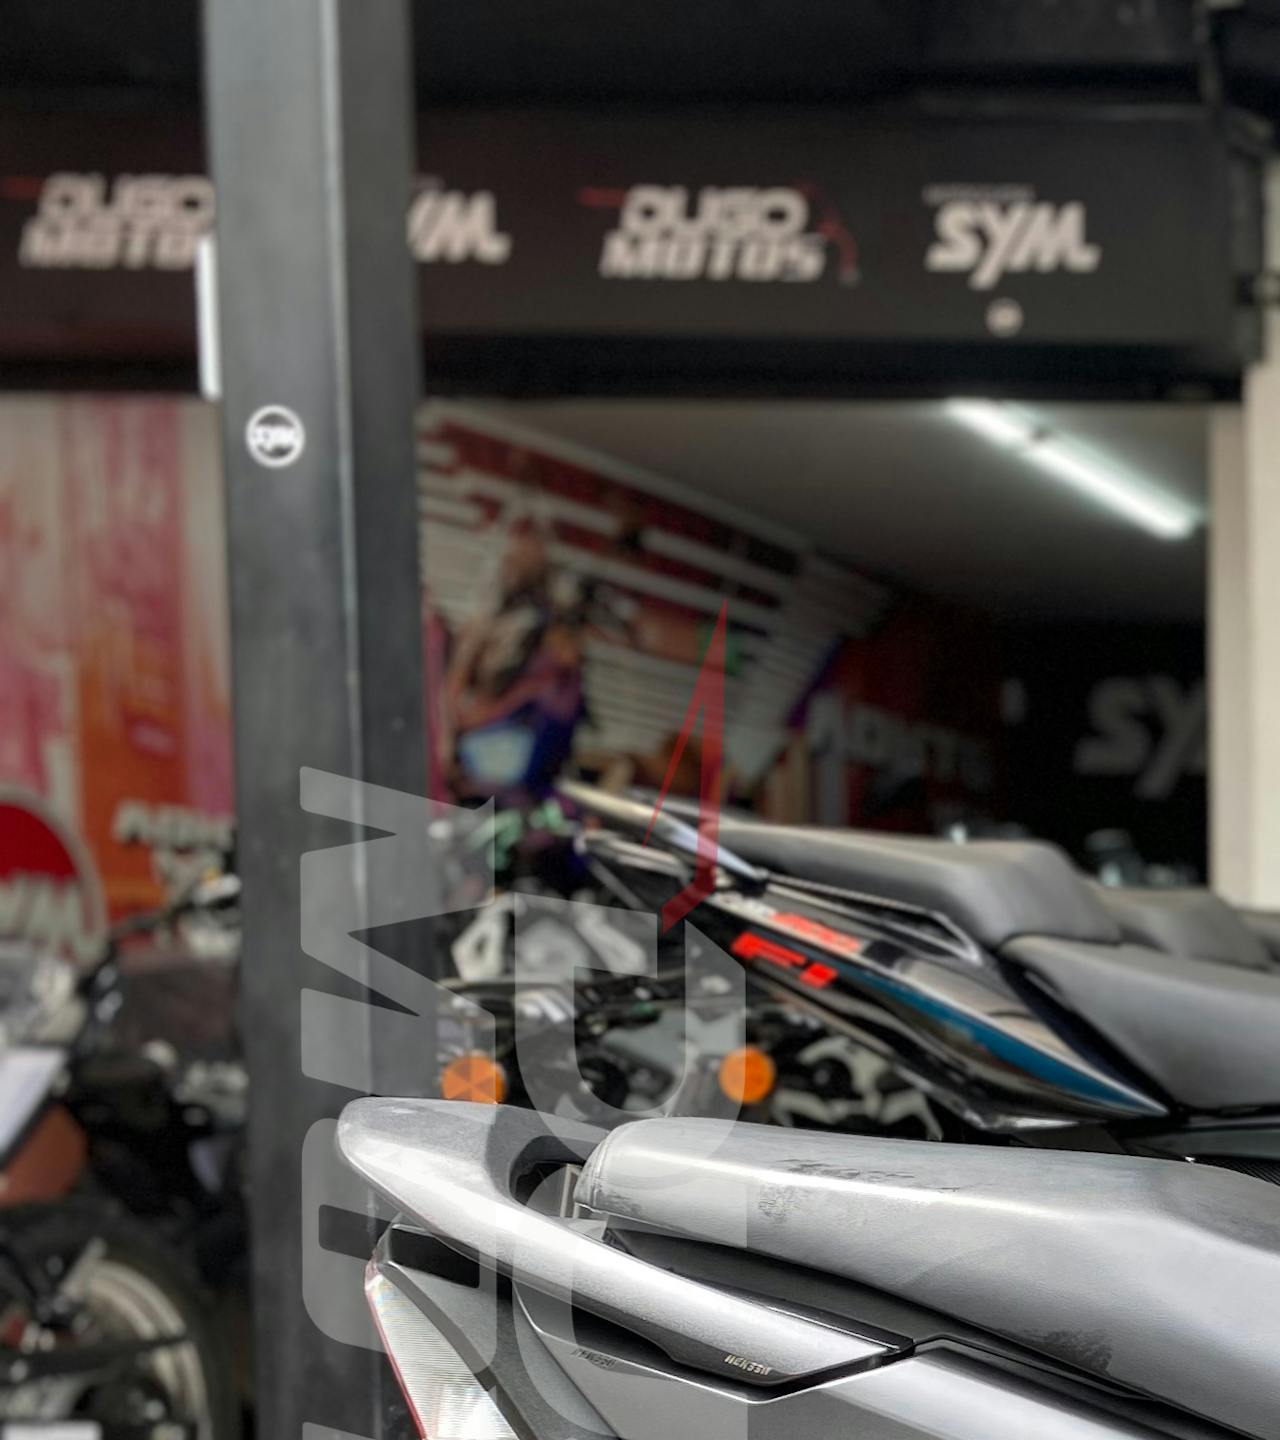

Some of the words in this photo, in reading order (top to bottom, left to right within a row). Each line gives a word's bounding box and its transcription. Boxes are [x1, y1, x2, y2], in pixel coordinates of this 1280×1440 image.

[621, 185, 809, 237] DUGO
[18, 216, 207, 270] MOTO
[599, 230, 827, 281] MOTOS
[924, 202, 1101, 289] SYM
[1073, 674, 1207, 801] SY
